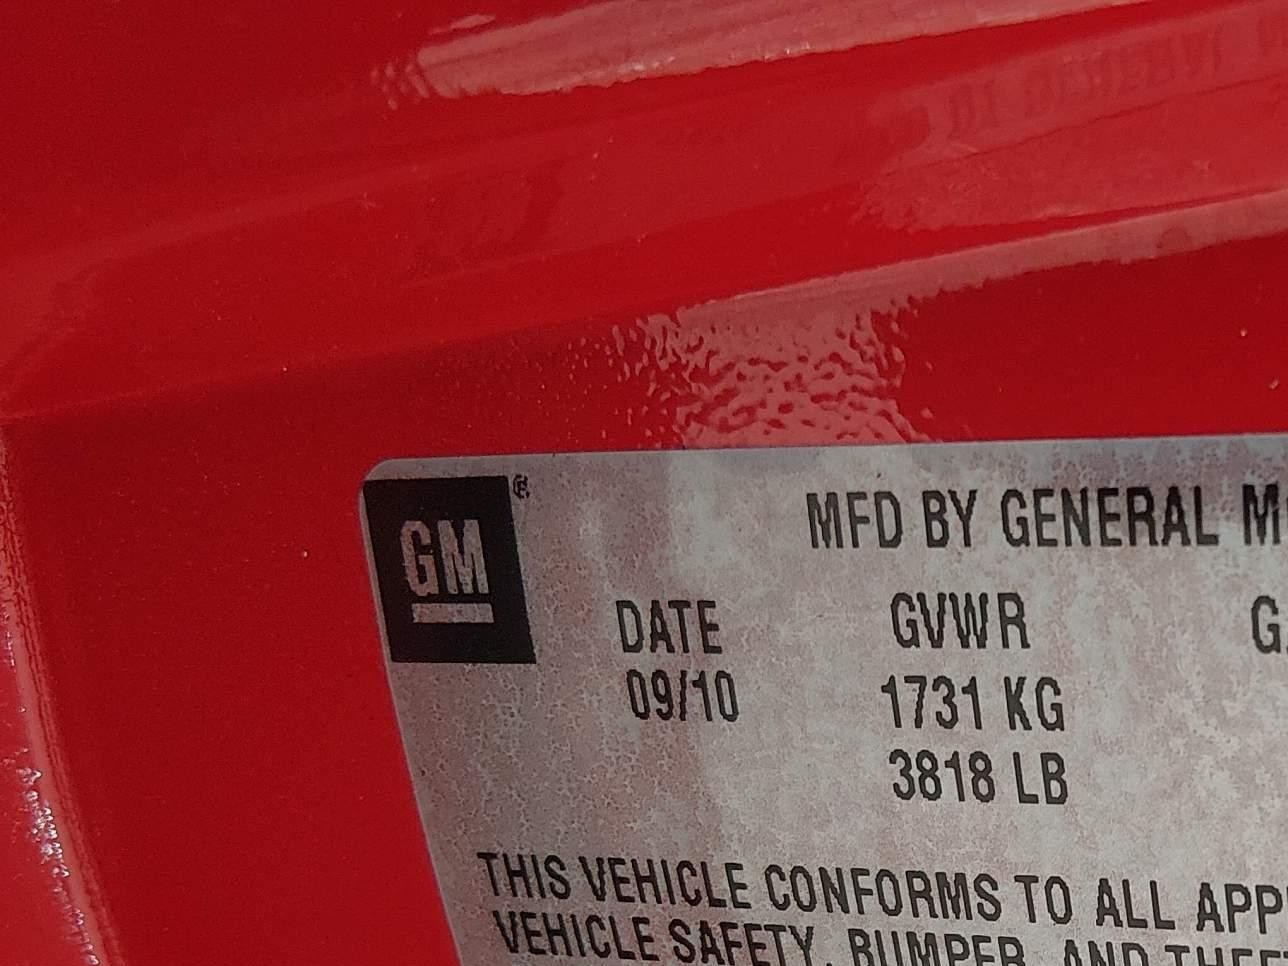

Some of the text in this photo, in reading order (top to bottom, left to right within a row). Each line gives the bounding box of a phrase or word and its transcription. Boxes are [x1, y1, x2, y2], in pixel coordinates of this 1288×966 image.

[807, 491, 901, 549] MFD
[923, 489, 978, 548] BY
[1001, 485, 1219, 548] GENERAL
[401, 519, 489, 596] GM
[616, 600, 723, 655] DATE
[890, 592, 1030, 650] GVWR
[625, 669, 739, 724] 09/10
[881, 675, 1065, 732] 1731 KG
[888, 750, 1069, 805] 3818 LB
[477, 851, 572, 900] THIS
[578, 856, 752, 910] VEHICLE
[764, 864, 1002, 922] CONFORMS
[1014, 873, 1074, 925] TO
[1096, 877, 1176, 930] ALL
[492, 910, 658, 963] VEHICLE
